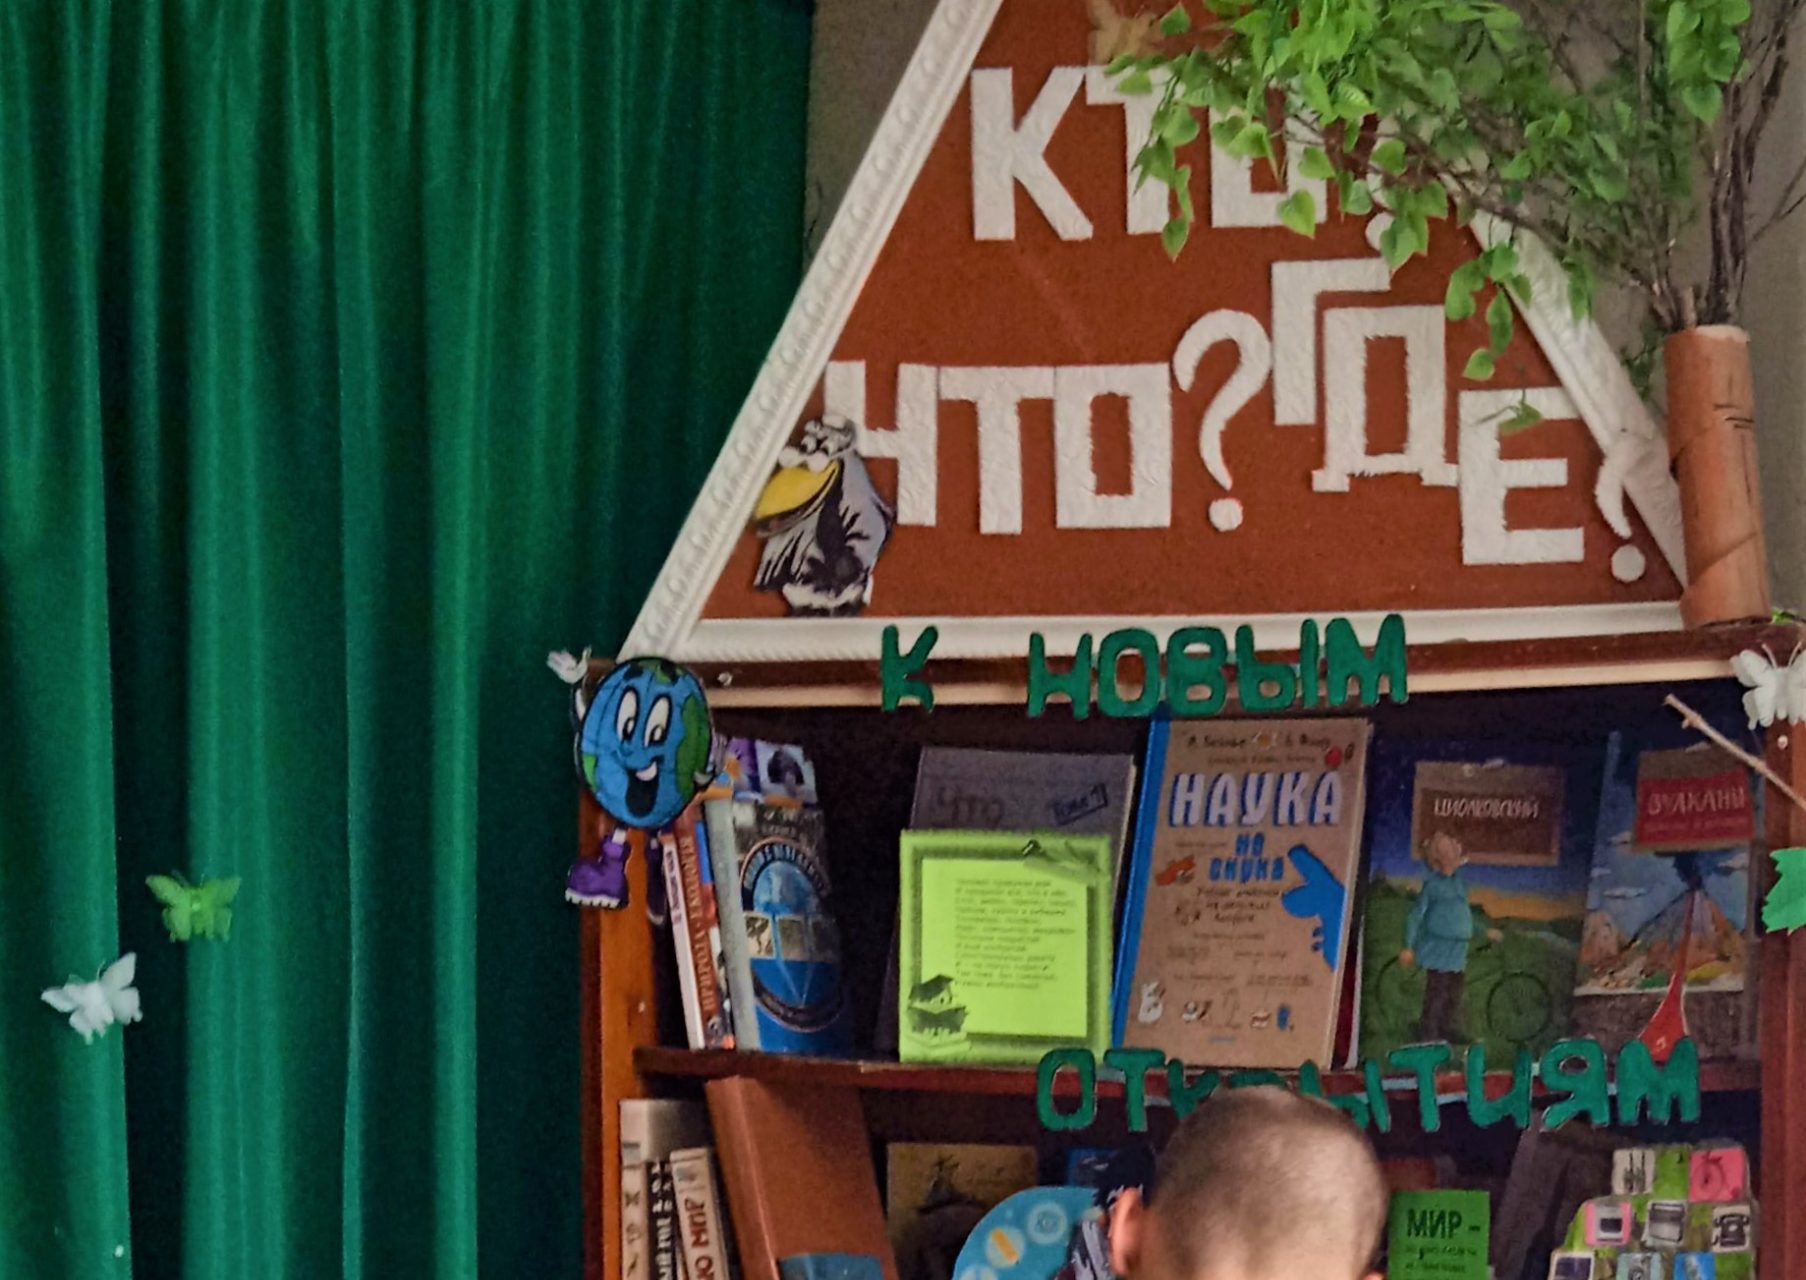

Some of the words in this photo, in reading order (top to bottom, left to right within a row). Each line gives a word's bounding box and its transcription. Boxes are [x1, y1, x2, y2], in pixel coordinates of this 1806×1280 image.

[971, 62, 1415, 251] КТО
[824, 308, 1272, 536] ЧТО?
[881, 625, 938, 713] К
[1028, 613, 1408, 719] НОВЫМ
[1168, 772, 1344, 827] НАУКА
[1037, 1038, 1699, 1133] ОТКЫТИЯМ
[684, 1195, 711, 1249] МИР
[1406, 1208, 1463, 1239] МИР
